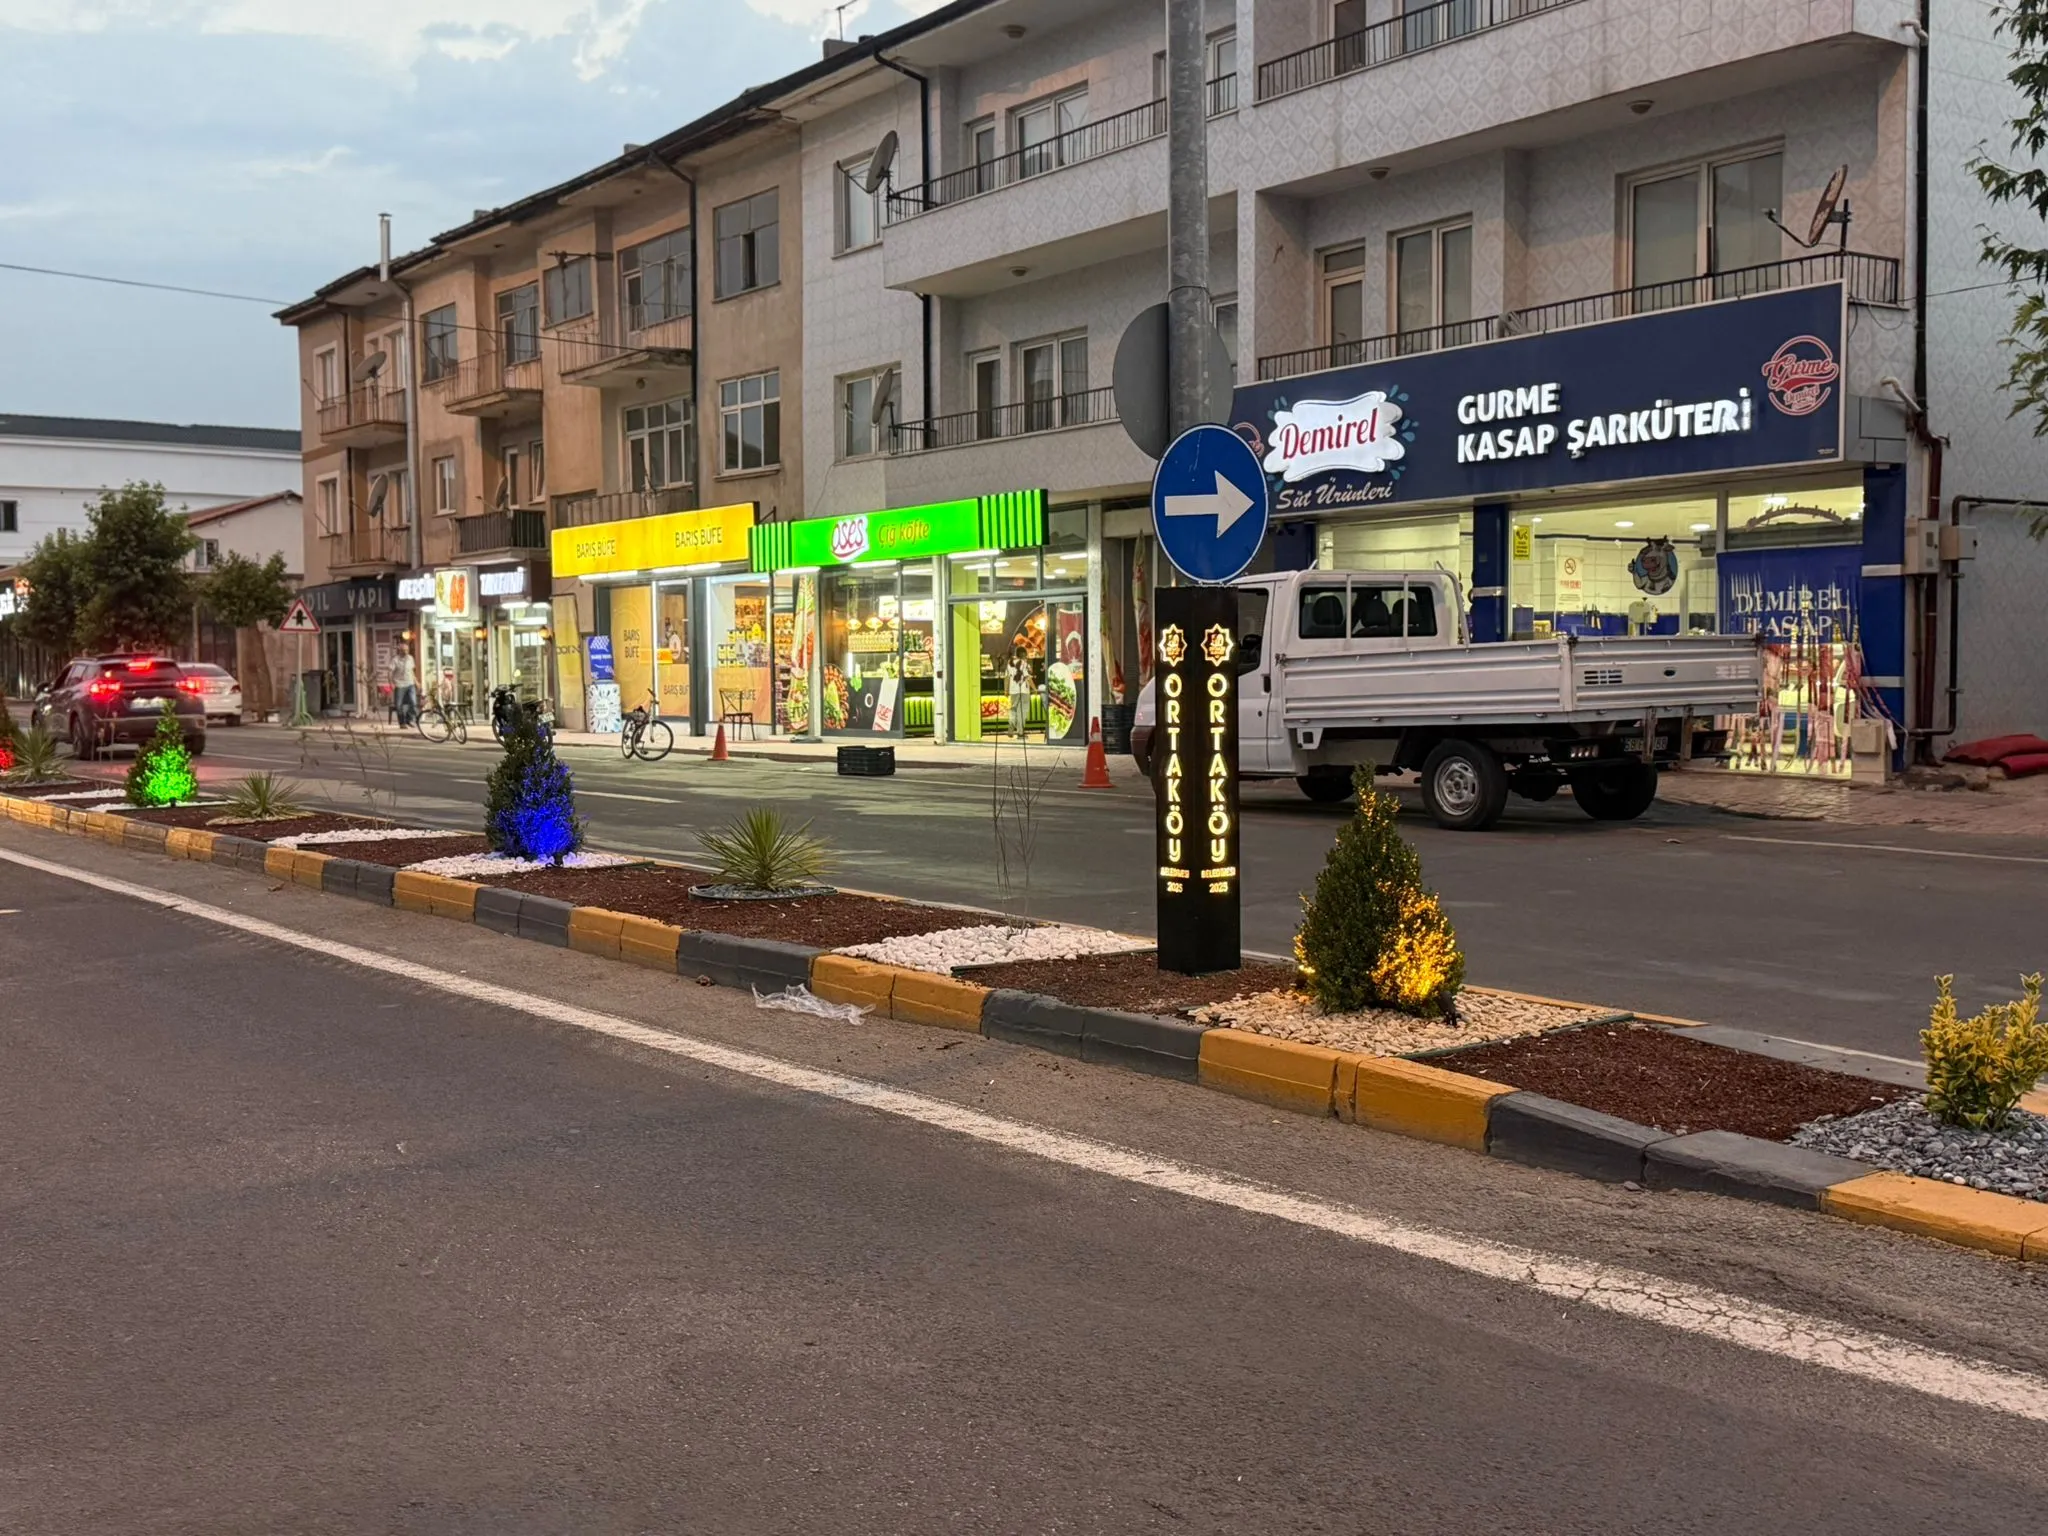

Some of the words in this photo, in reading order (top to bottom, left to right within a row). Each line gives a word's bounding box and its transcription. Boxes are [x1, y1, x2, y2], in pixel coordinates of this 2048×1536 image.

[1761, 353, 1836, 391] Gurme
[1457, 382, 1561, 425] GURME
[1279, 407, 1378, 460] Demirel
[1457, 424, 1558, 463] KASAP
[1567, 387, 1752, 459] ŞARKÜTERİ
[1275, 489, 1312, 509] Süt
[1315, 476, 1393, 505] Ürünleri
[577, 541, 596, 561] BARIŞ
[597, 536, 616, 556] BÜFE
[675, 530, 698, 551] BARIŞ
[700, 524, 723, 545] BÜFE
[899, 519, 930, 545] köfte
[347, 587, 382, 609] YAPI
